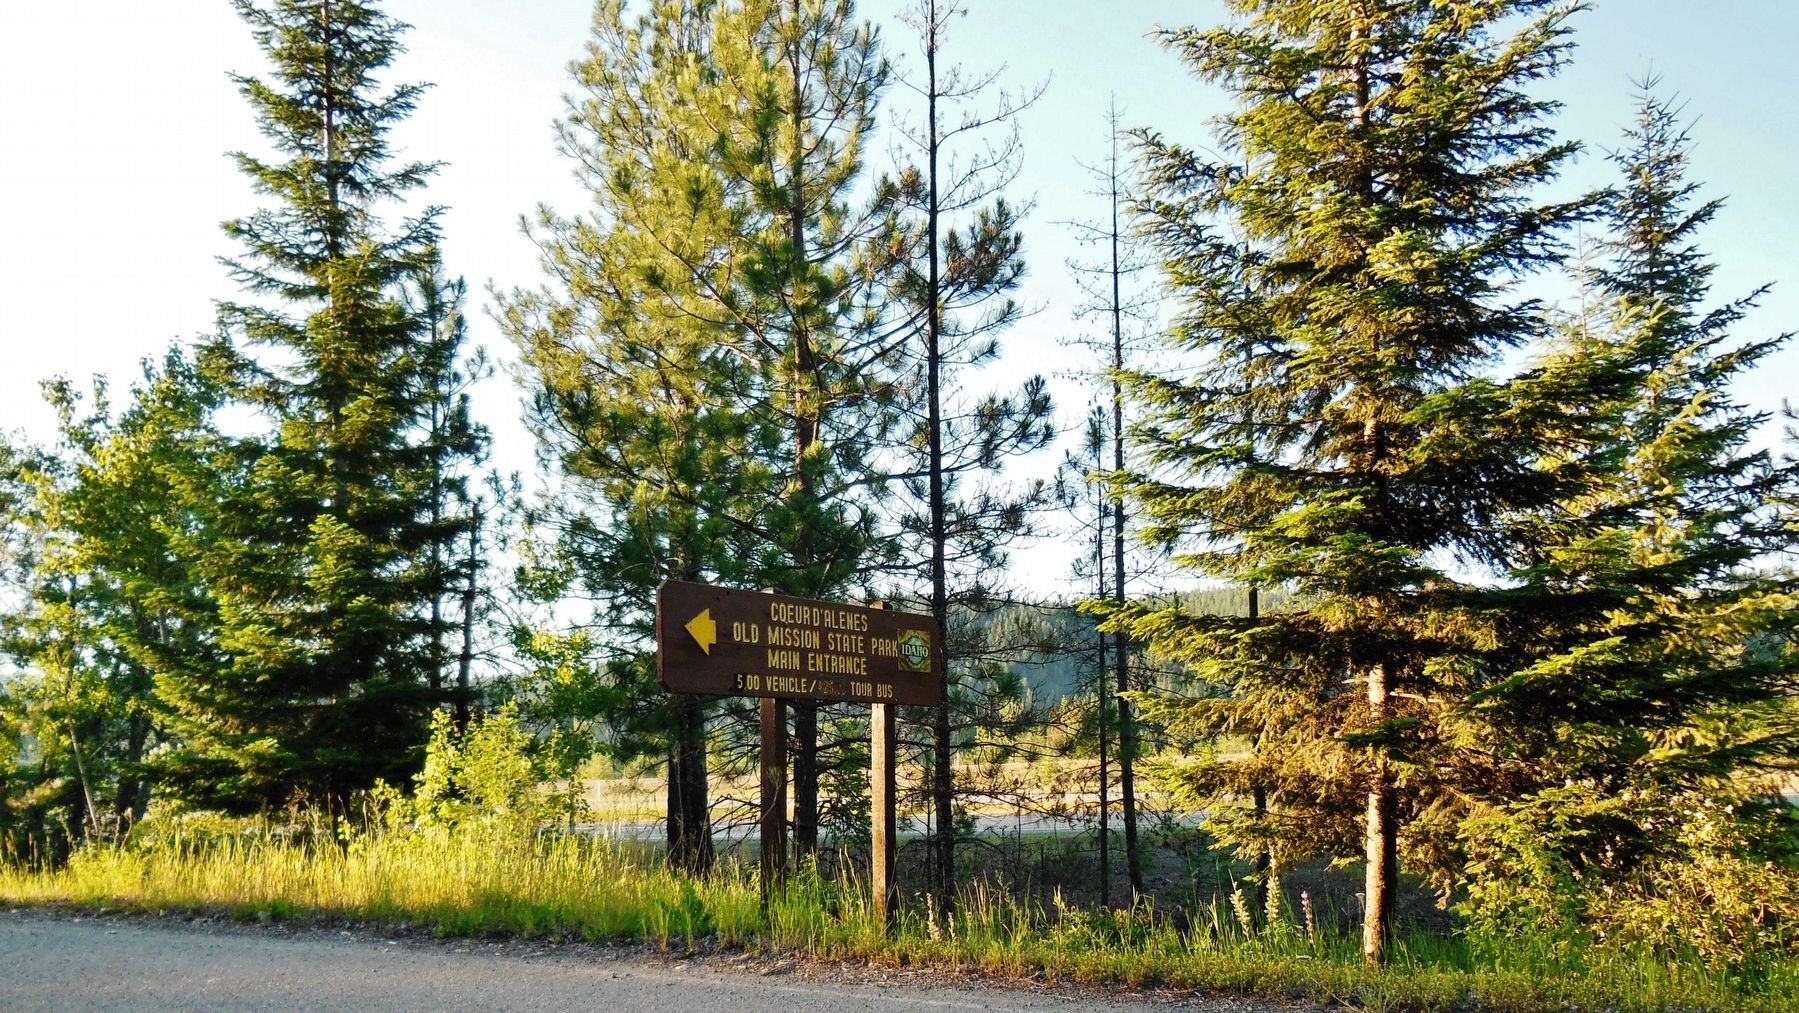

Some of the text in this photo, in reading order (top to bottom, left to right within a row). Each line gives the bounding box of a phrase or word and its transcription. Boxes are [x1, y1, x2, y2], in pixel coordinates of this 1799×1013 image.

[771, 601, 868, 632] COEUR D'ALENES
[733, 621, 898, 657] OLD MISSION STATE PARK
[901, 643, 929, 658] IDAHO
[767, 648, 868, 675] MAIN ENTRANCE
[850, 681, 873, 697] TOUR
[876, 682, 894, 698] BUS
